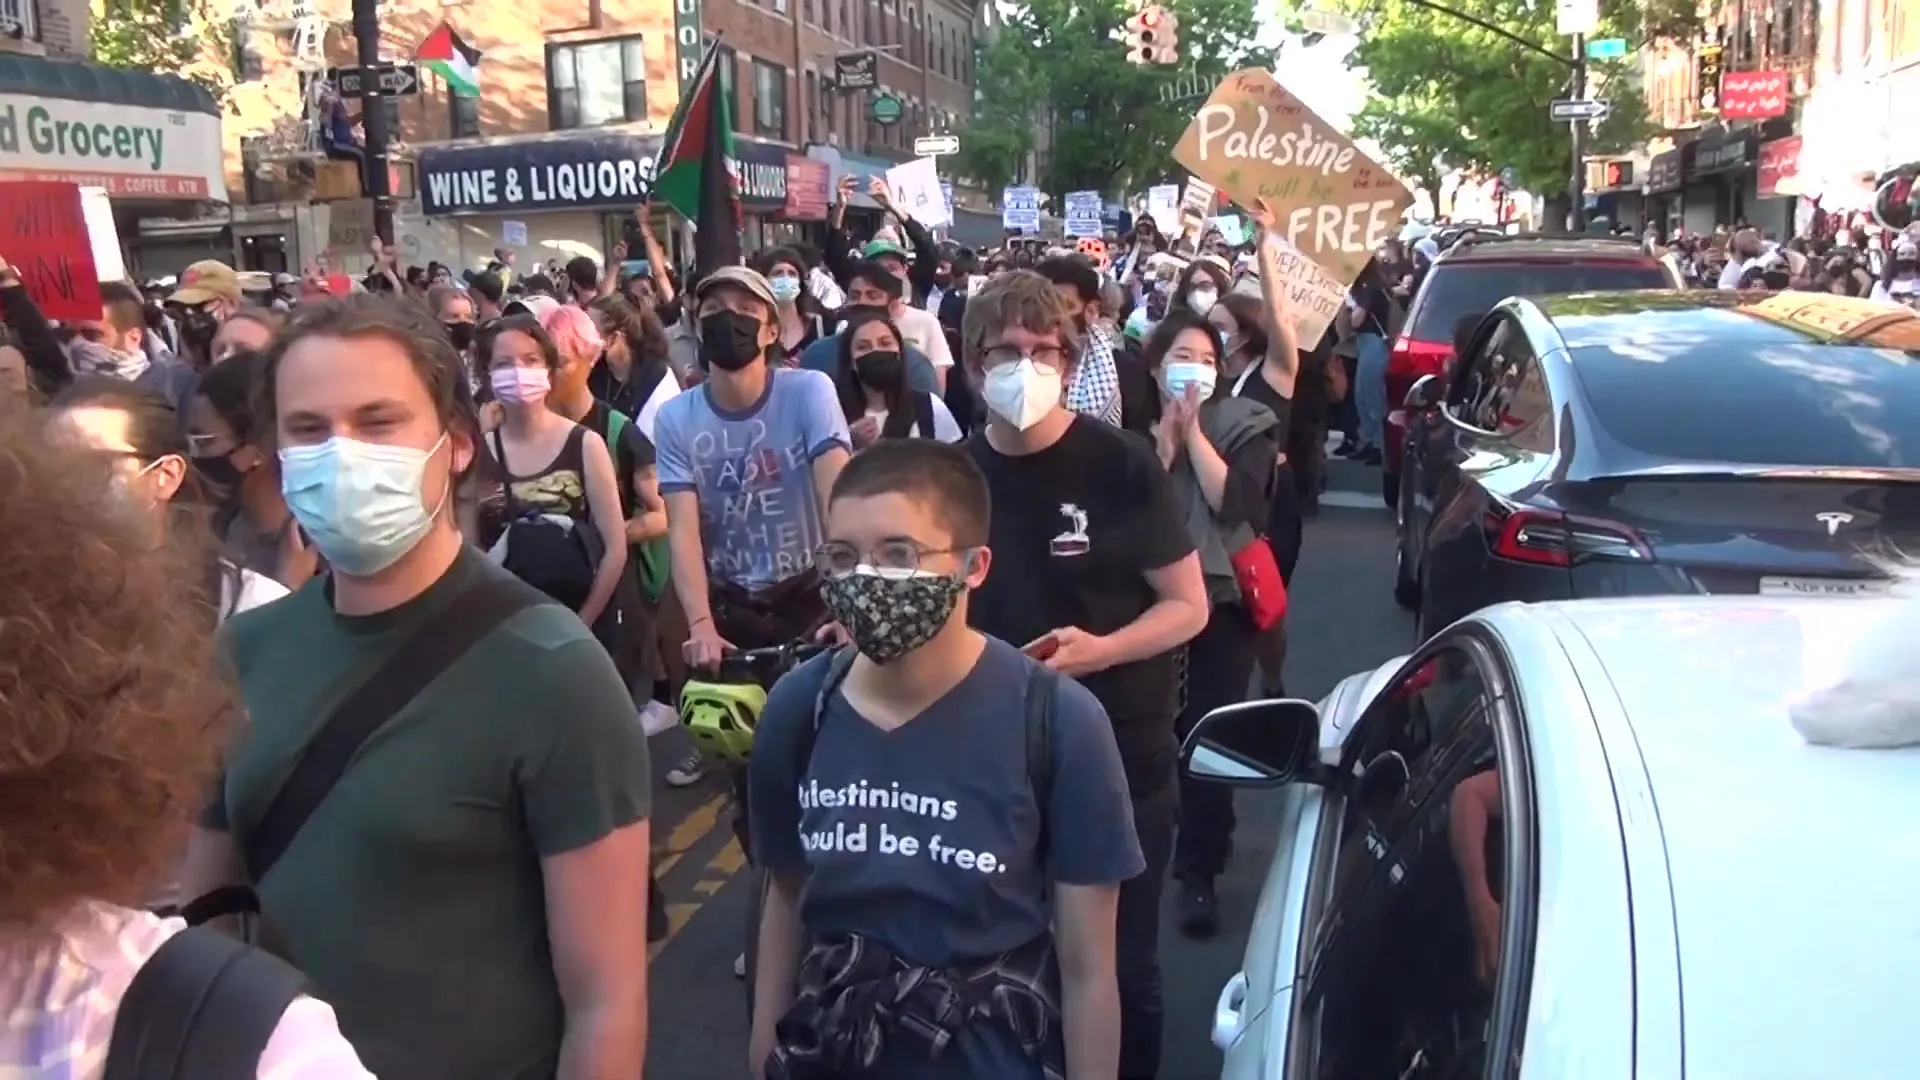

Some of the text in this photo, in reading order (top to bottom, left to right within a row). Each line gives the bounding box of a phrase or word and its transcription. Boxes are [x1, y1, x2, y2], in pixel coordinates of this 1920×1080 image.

[27, 106, 163, 171] Grocery
[1198, 103, 1354, 176] Palestine
[429, 156, 655, 206] WINE & LIQUORS
[1287, 199, 1395, 254] FREE
[879, 823, 919, 856] be
[928, 834, 1006, 873] free.
